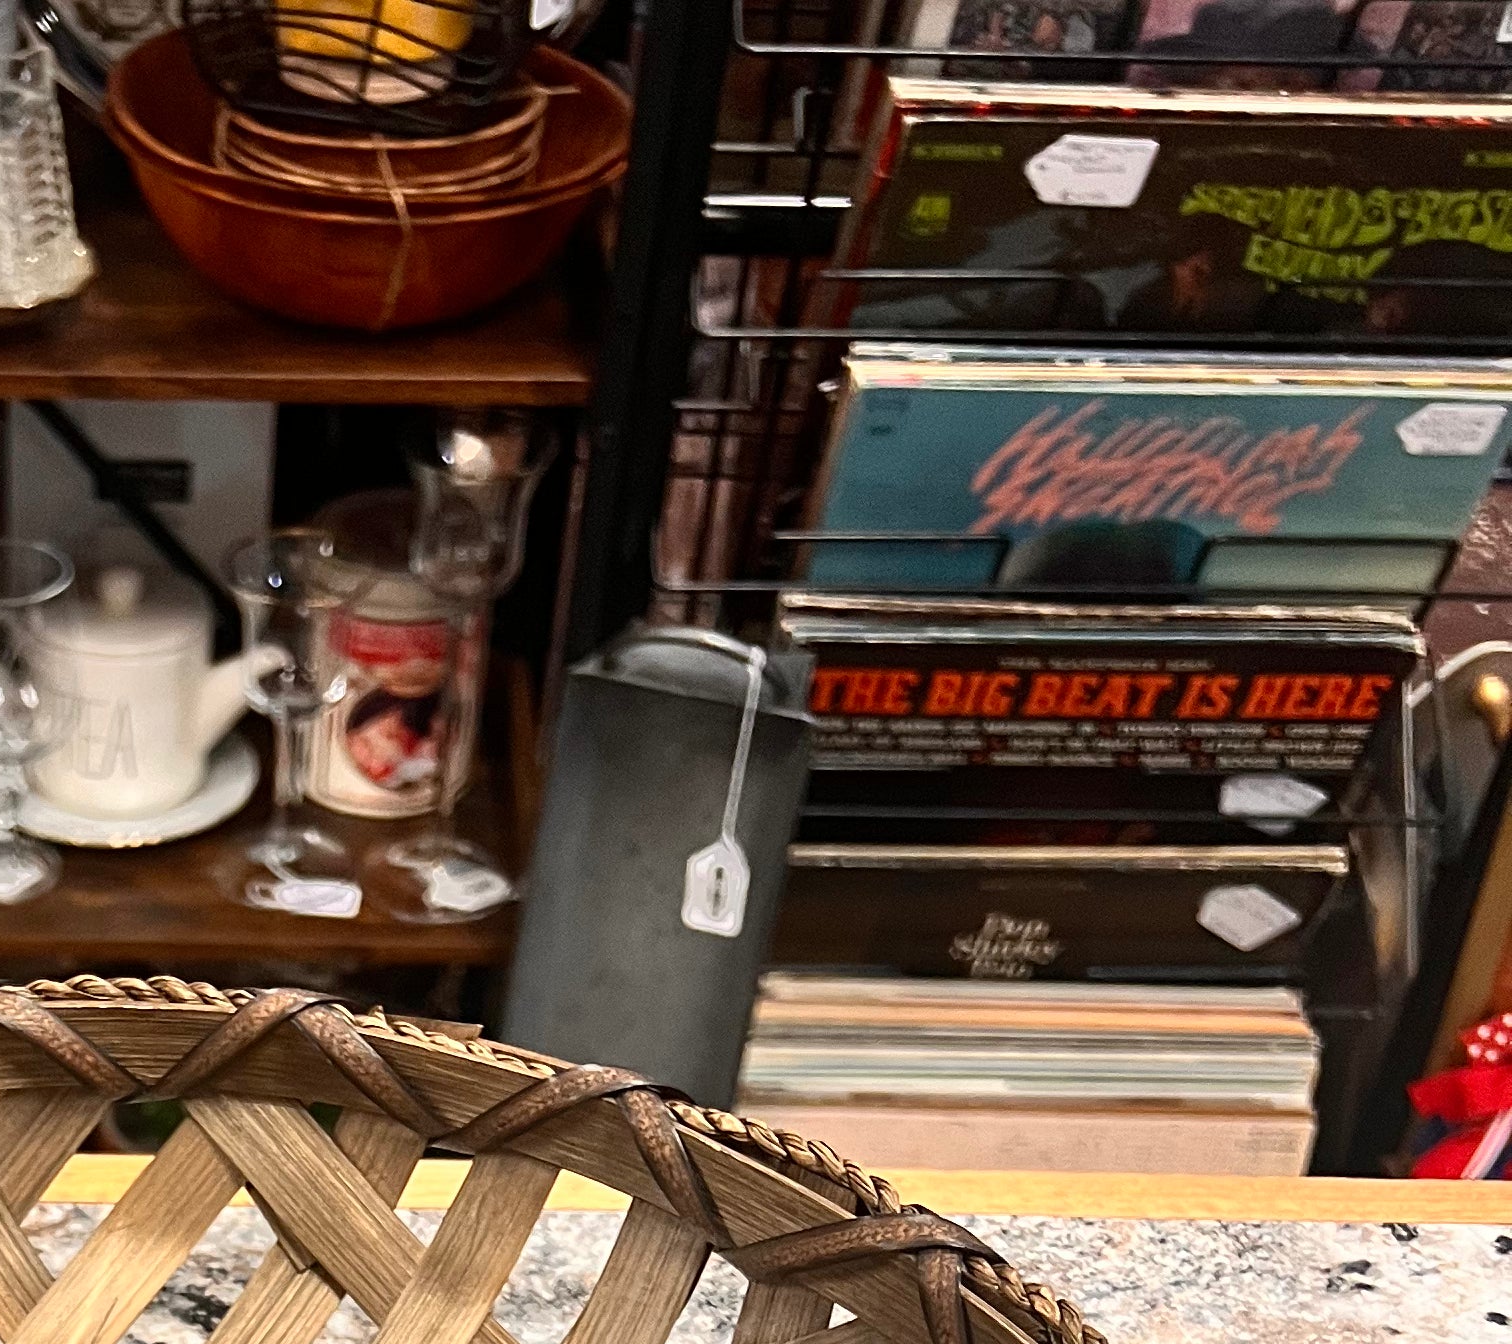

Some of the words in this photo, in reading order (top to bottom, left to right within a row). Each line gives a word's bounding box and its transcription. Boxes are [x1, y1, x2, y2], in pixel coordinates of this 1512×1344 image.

[809, 667, 922, 716] THE
[922, 668, 1021, 718] BIG
[1022, 671, 1174, 719] BEAT
[1176, 673, 1239, 720] IS
[1240, 672, 1393, 720] HERE
